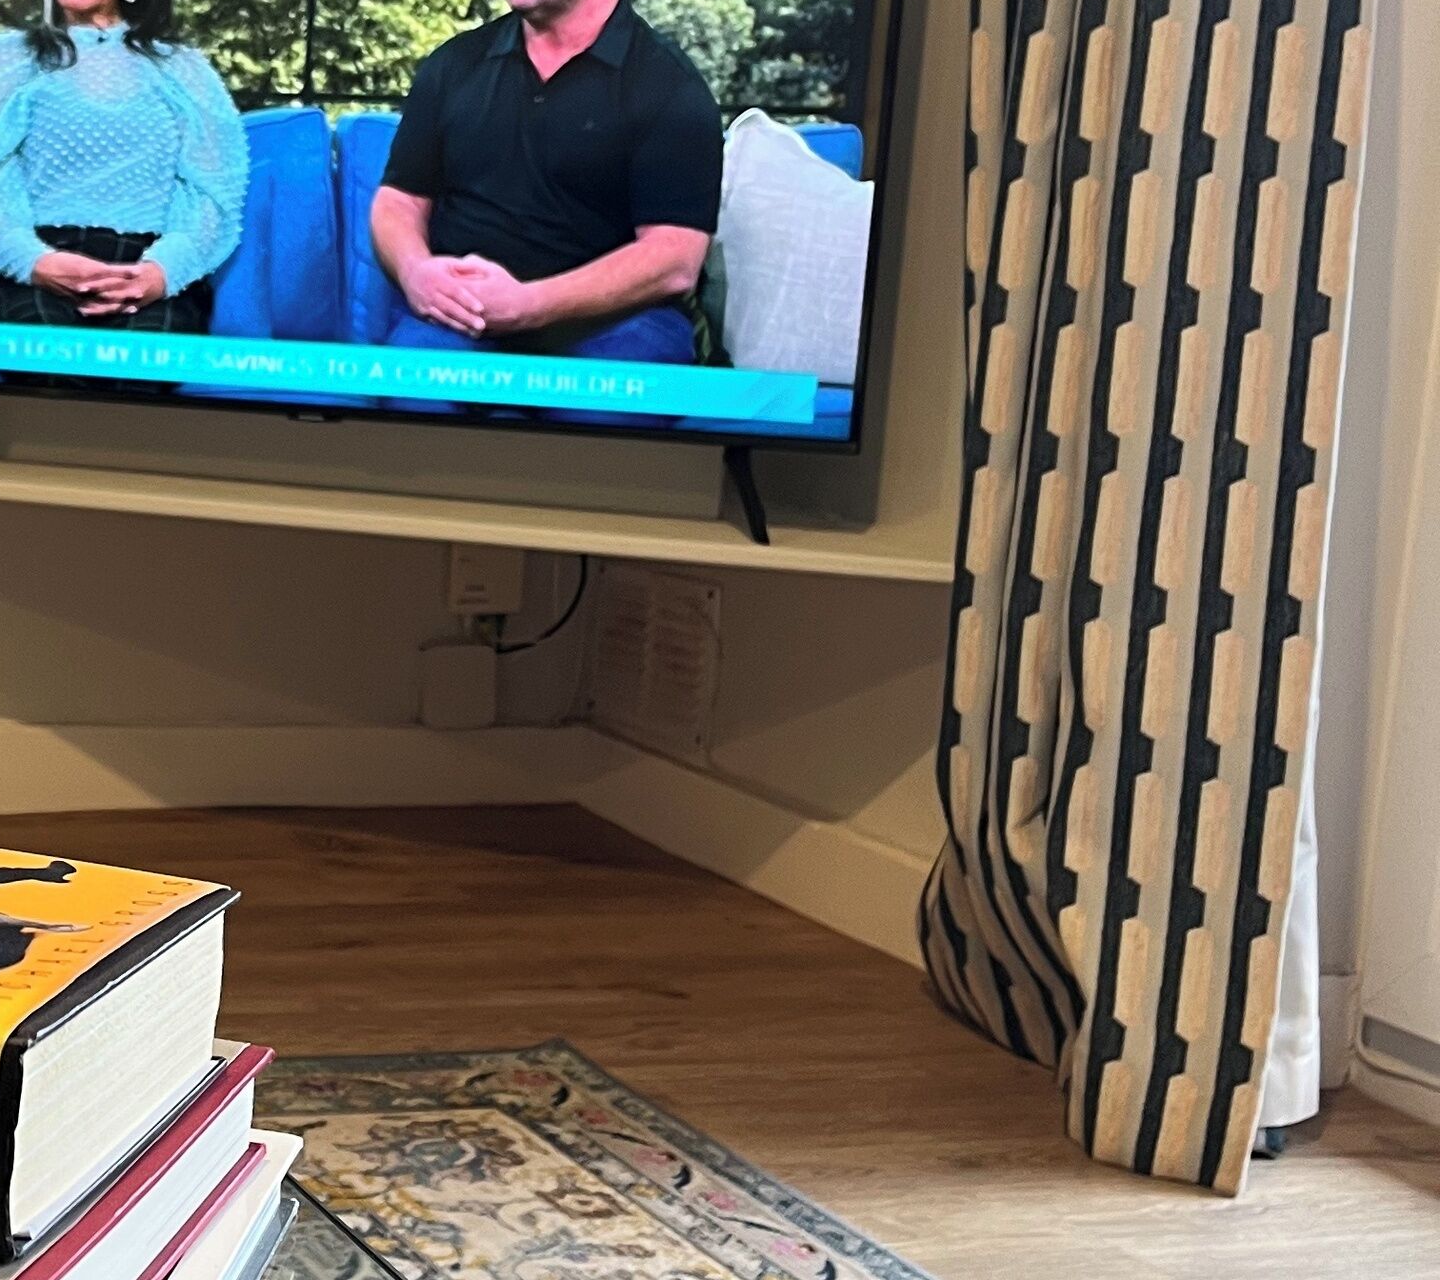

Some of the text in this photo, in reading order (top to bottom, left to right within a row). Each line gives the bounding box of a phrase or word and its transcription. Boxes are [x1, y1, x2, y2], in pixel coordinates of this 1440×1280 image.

[23, 337, 85, 362] LOST
[95, 342, 130, 365] MY
[207, 350, 313, 377] SAVINGS
[327, 357, 358, 378] TO
[368, 360, 384, 380] A
[395, 364, 515, 389] COWBOY
[98, 880, 194, 927] GROSS
